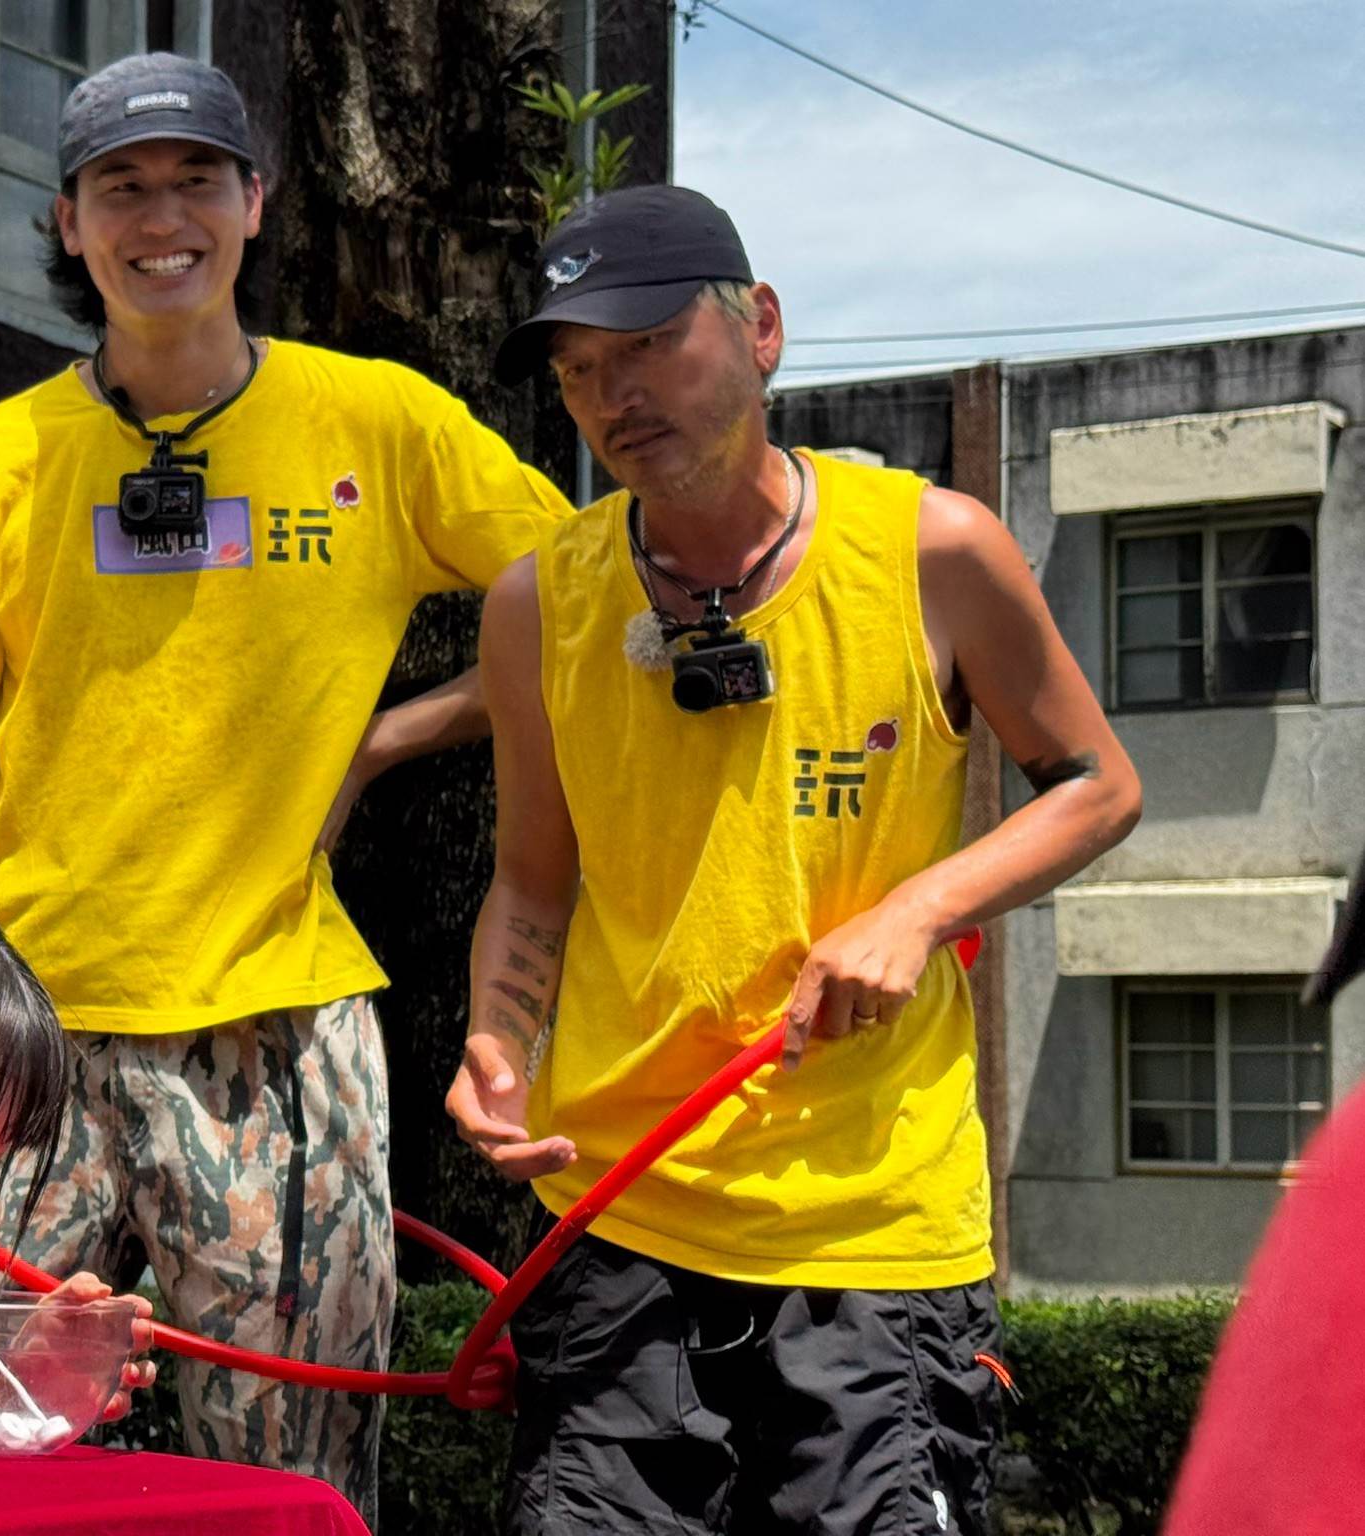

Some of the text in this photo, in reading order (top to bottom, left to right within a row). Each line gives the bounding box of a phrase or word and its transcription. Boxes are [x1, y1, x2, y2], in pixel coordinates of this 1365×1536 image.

[127, 91, 190, 109] Supreme
[267, 507, 333, 566] 玩
[794, 748, 866, 818] 玩
